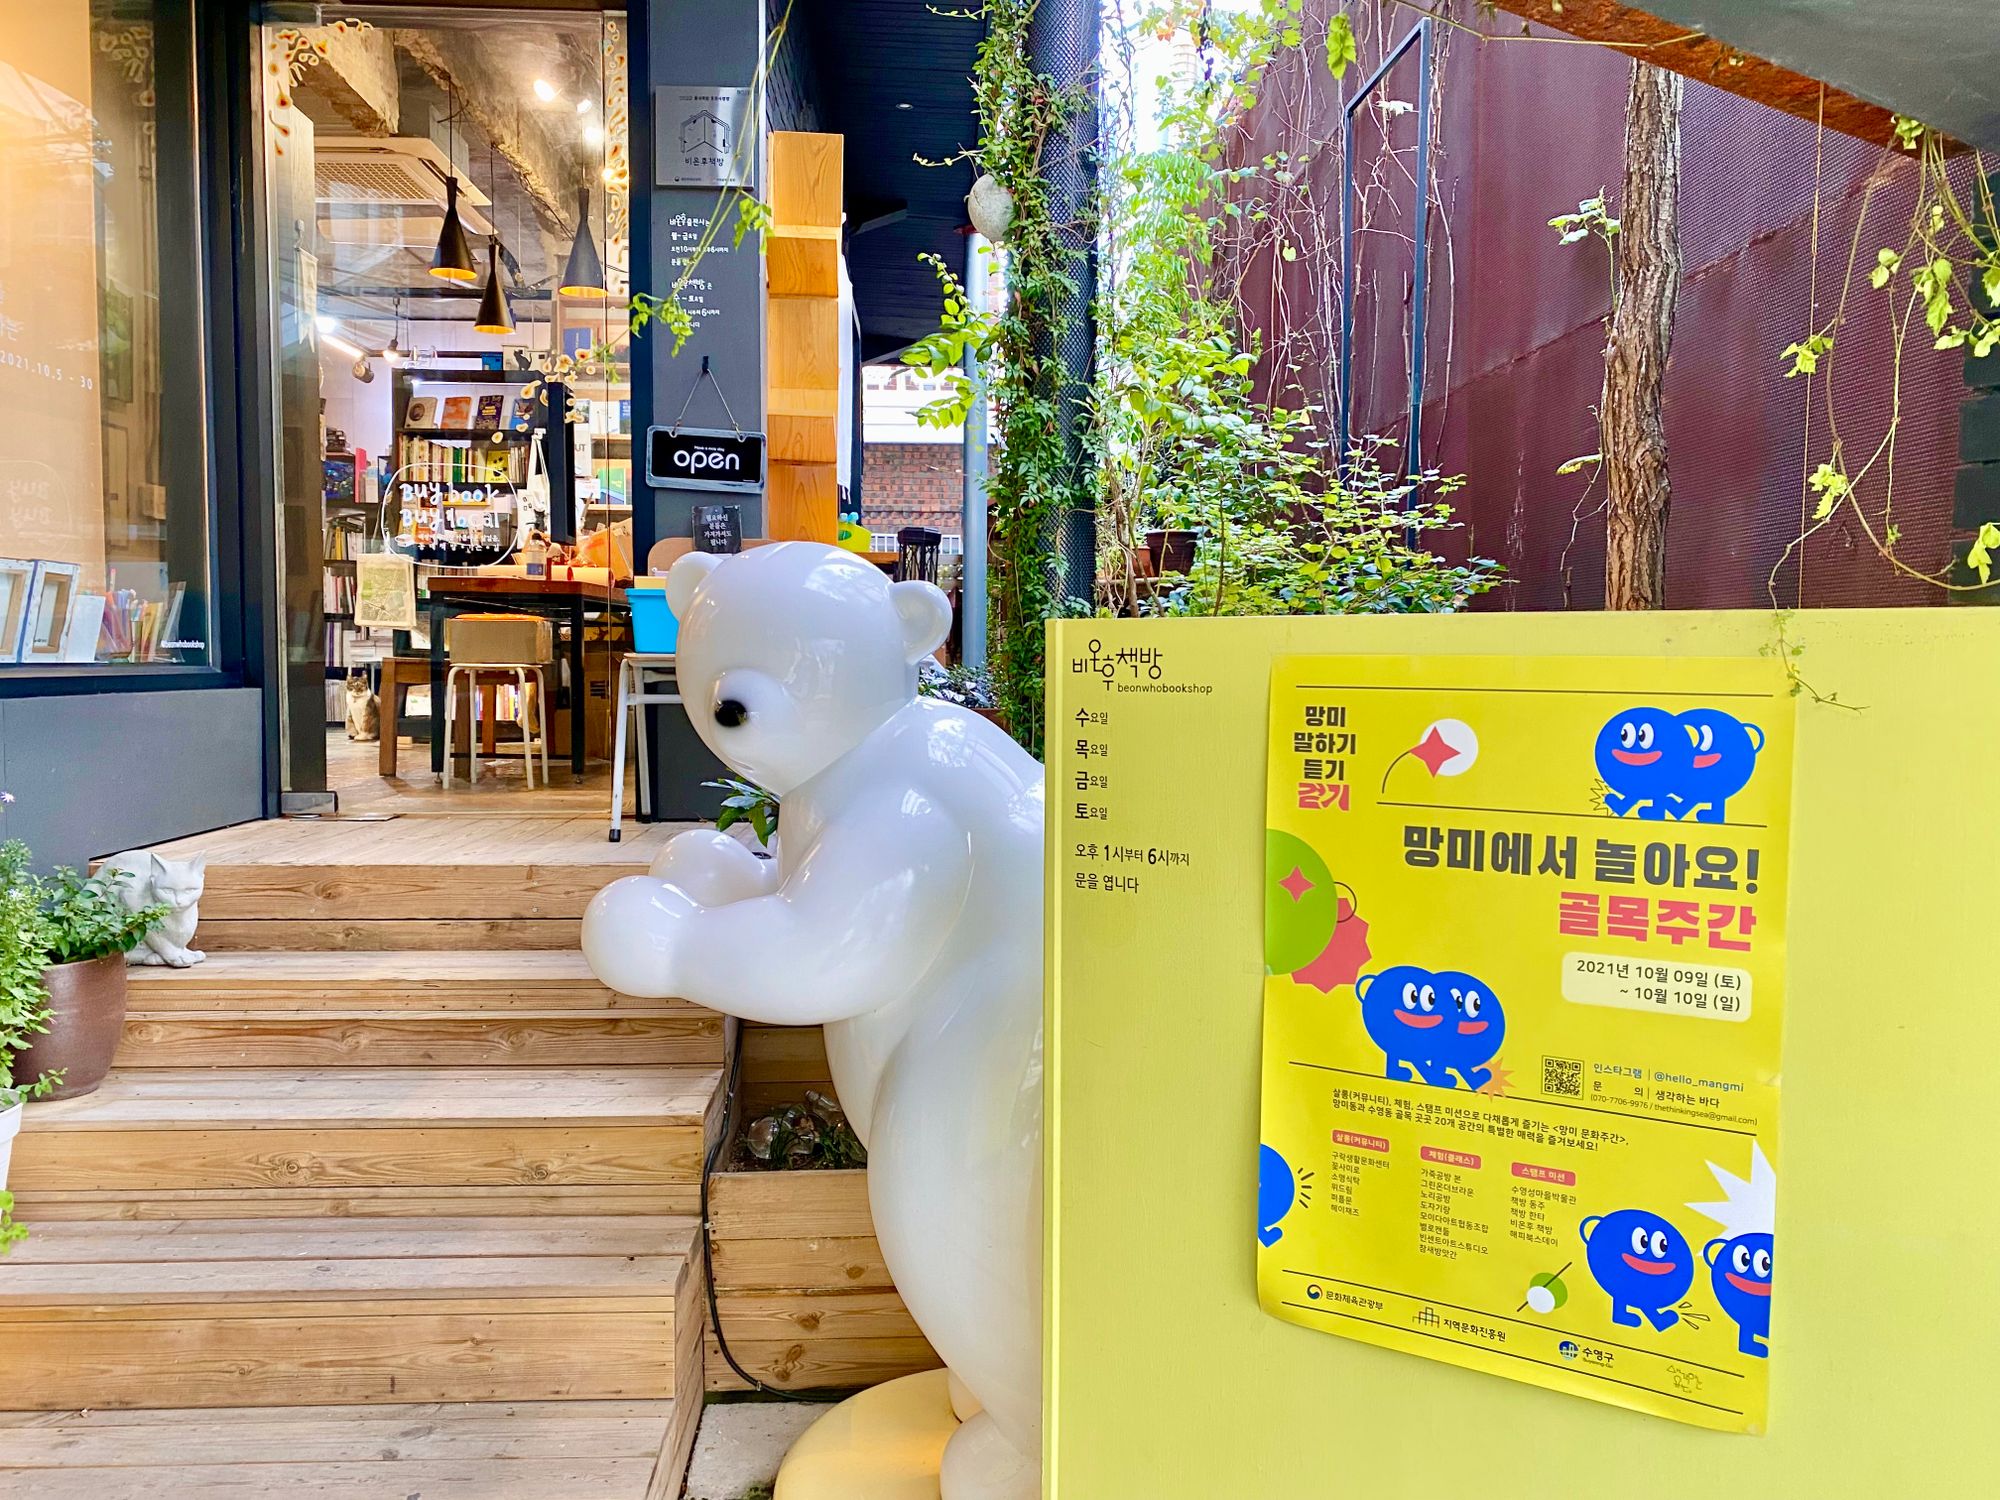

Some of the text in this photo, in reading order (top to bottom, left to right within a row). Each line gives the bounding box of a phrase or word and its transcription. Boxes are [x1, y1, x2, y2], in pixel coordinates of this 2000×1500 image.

[673, 449, 740, 475] open
[1117, 683, 1213, 694] beonwhobookshop
[1075, 708, 1108, 727] 수요일
[1305, 706, 1346, 727] 망미
[1075, 740, 1108, 759] 목요일
[1294, 732, 1356, 755] 말하기
[1075, 771, 1108, 790] 금요일
[1304, 759, 1344, 781] 듣기
[1298, 782, 1350, 811] 걷기
[1075, 803, 1108, 820] 토요일
[1075, 844, 1190, 866] 오후 1시부터 6시까지
[1404, 825, 1760, 895] 망미에서 놀아요!
[1075, 872, 1139, 893] 문을 엽니다
[1559, 891, 1757, 952] 골목주간
[1576, 959, 1742, 991] 2021년 10월 09일 (토)
[1634, 987, 1668, 1004] 10월
[1673, 991, 1708, 1010] 10일
[1713, 994, 1741, 1013] (일)
[1593, 1063, 1744, 1092] 인스타그램 @hello_mangmi
[1655, 1089, 1696, 1106] 생각하는
[1699, 1096, 1720, 1109] 바다
[1522, 1118, 1550, 1132] 즐기는
[1654, 1102, 1758, 1126] thethinkingsea@gmail.com)
[1434, 1115, 1456, 1128] 20개
[1458, 1121, 1485, 1133] 공간의
[1487, 1124, 1514, 1139] 특별한
[1326, 1290, 1383, 1311] 문화체육관광부
[1443, 1318, 1506, 1342] 지역문화진흥원
[1582, 1347, 1614, 1363] 수영구
